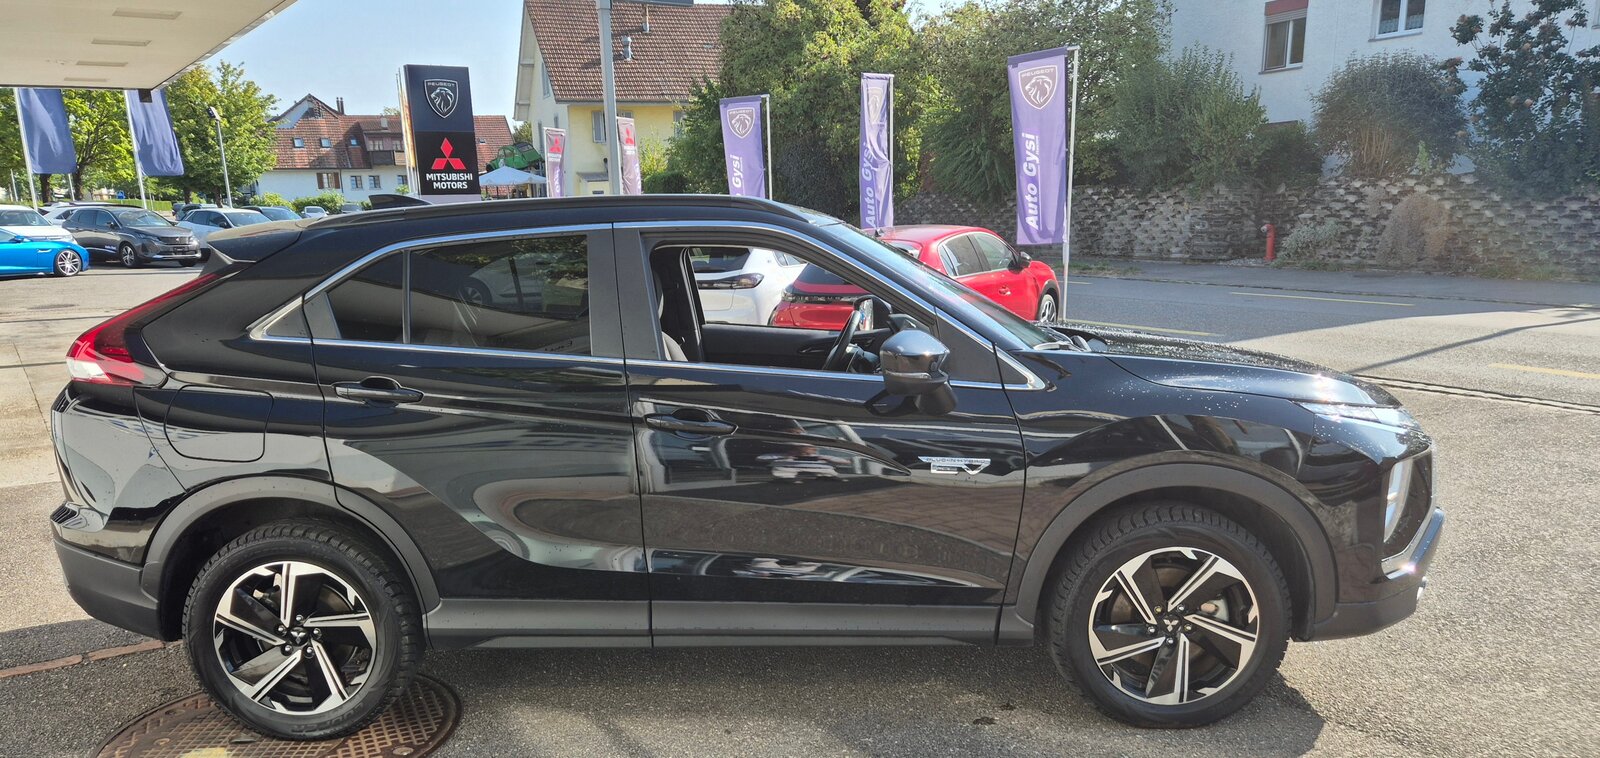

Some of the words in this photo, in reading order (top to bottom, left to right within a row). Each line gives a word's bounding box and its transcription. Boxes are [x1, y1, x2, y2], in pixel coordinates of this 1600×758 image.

[1021, 68, 1055, 77] PEUGEOT
[730, 154, 744, 188] Gysi
[1022, 133, 1040, 177] Gysi
[426, 173, 473, 181] MITSUBISHI
[865, 187, 876, 230] Auto
[1025, 183, 1039, 231] Auto
